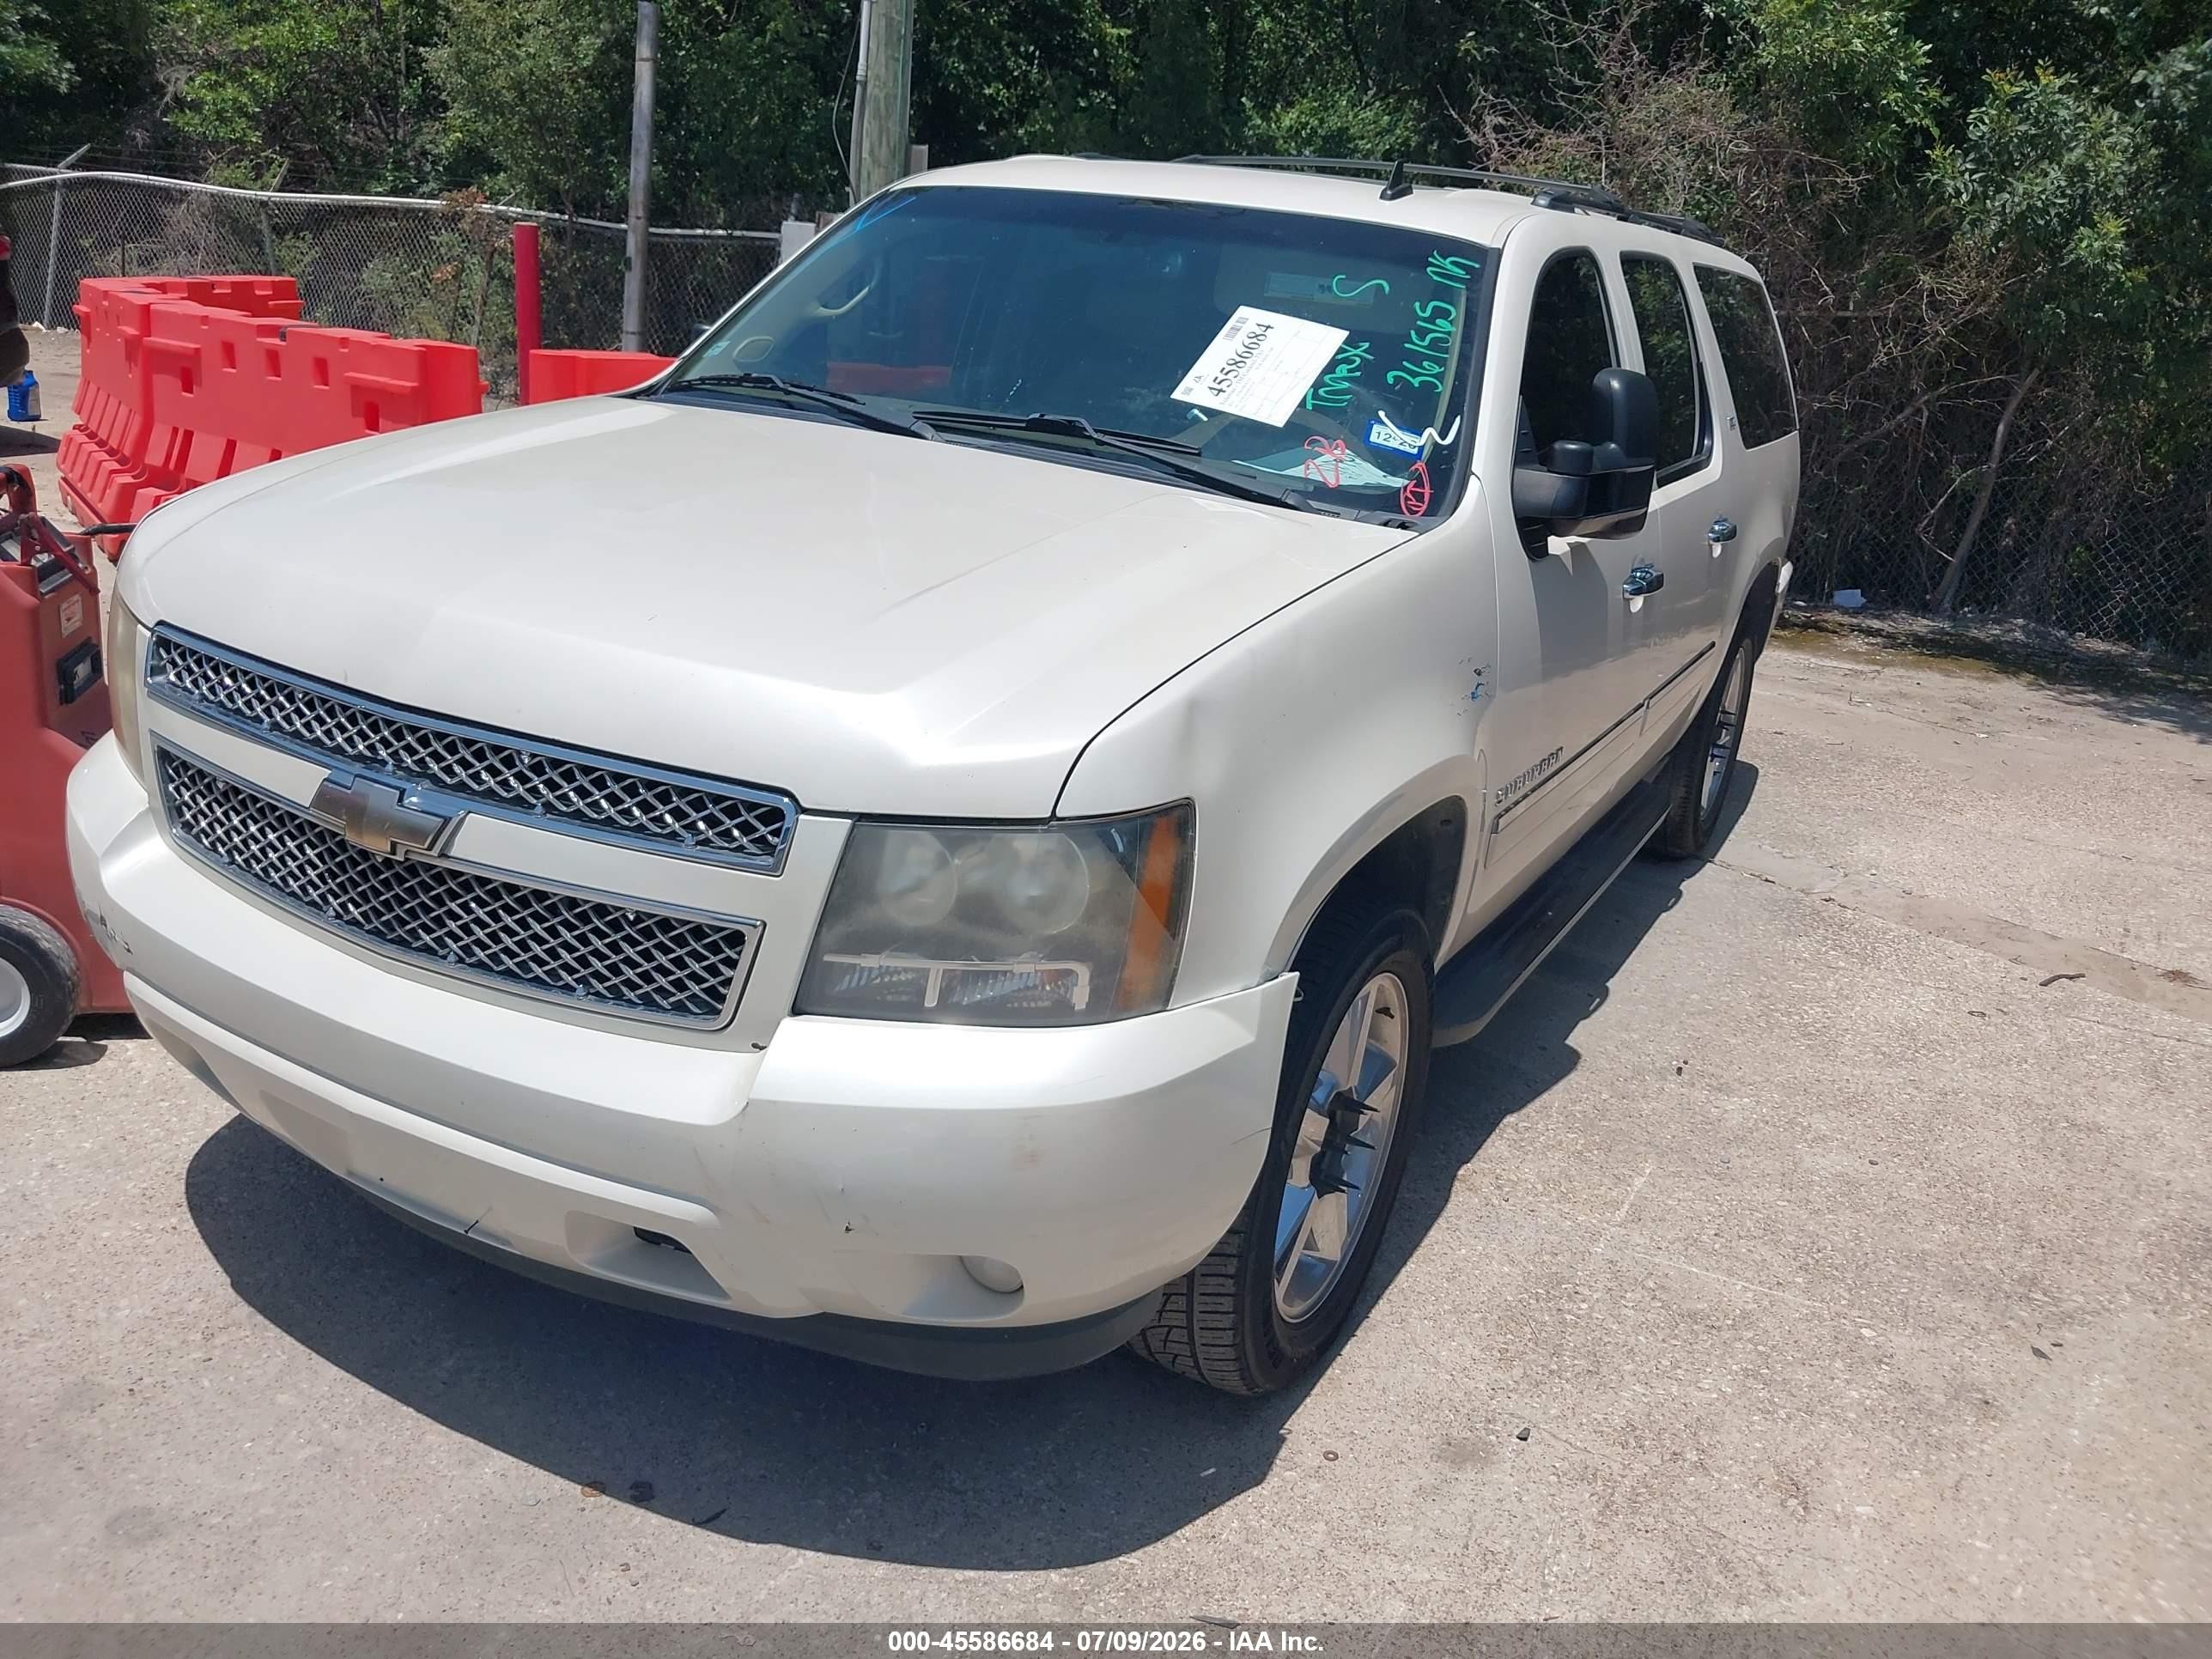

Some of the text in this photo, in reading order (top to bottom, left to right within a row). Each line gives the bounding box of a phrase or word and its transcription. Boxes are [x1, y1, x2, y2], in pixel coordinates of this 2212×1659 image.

[1206, 322, 1275, 397] 45586684
[1386, 301, 1457, 392] 361565
[1375, 431, 1393, 443] 12
